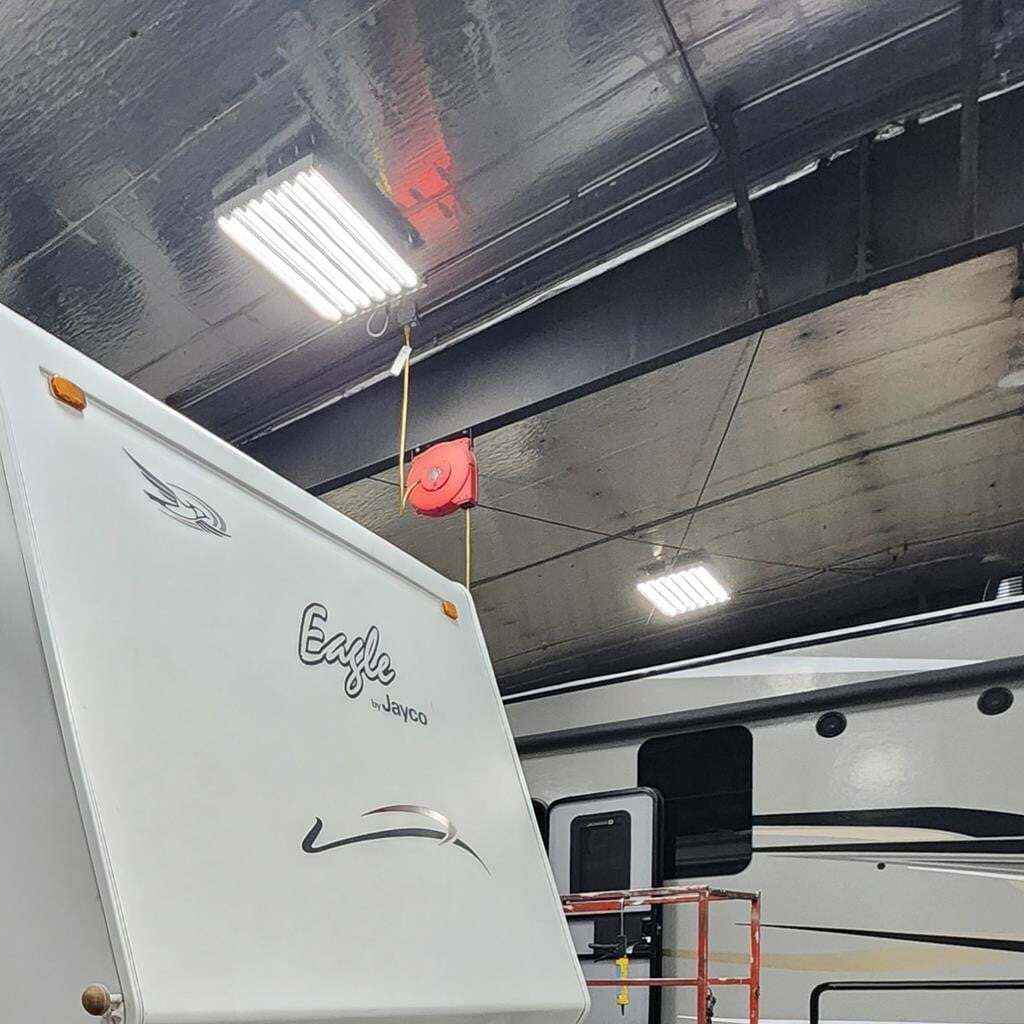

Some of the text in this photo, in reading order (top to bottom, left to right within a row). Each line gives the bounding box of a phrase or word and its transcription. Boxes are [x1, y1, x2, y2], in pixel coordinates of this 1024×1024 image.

[298, 602, 396, 699] Eagle
[370, 694, 428, 725] by Jayco
